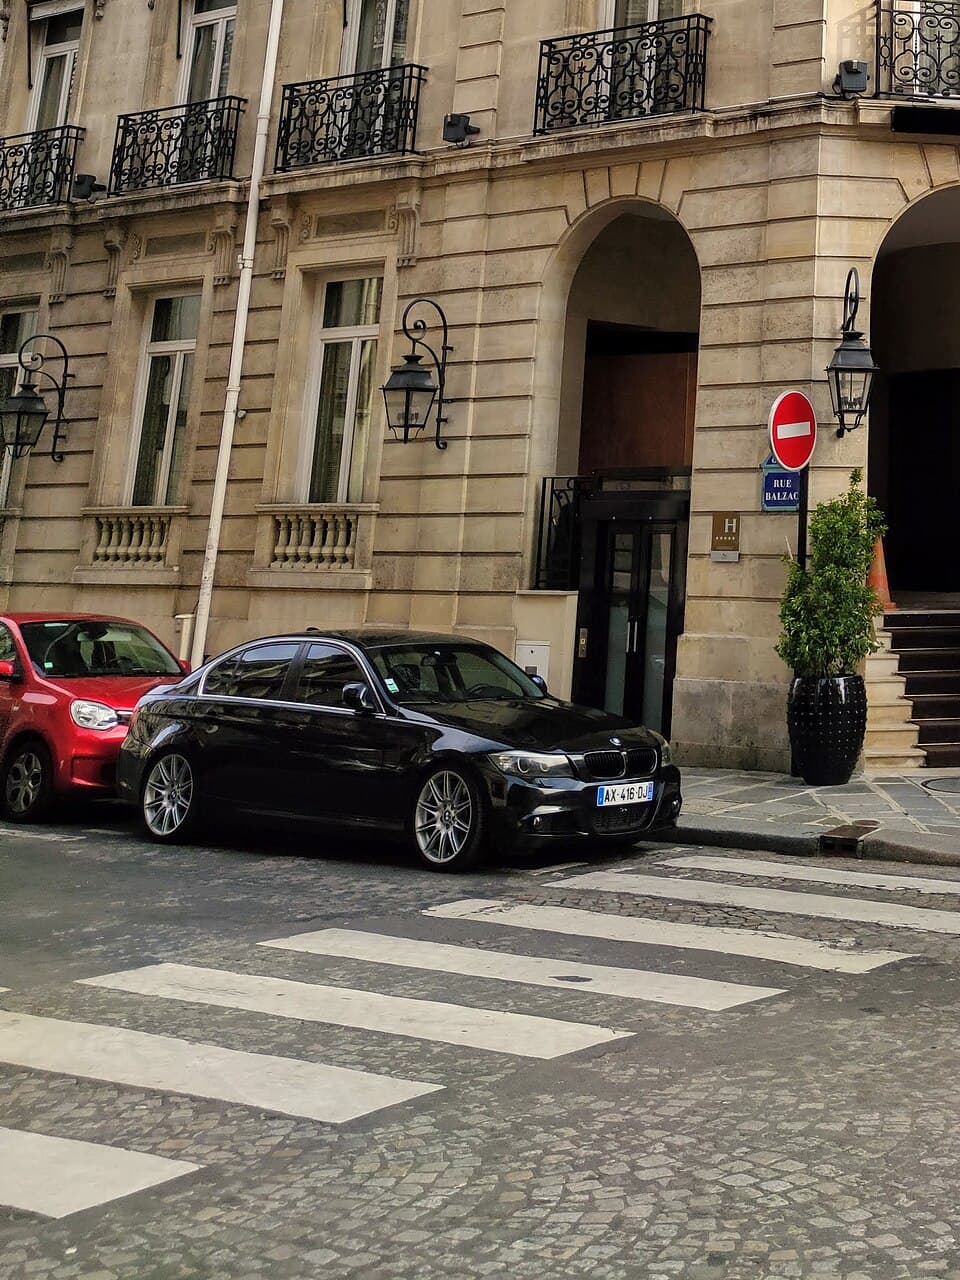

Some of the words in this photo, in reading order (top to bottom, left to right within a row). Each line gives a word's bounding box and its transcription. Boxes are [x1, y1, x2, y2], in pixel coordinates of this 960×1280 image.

[773, 479, 792, 488] RUE
[765, 491, 799, 501] BALZAC
[724, 518, 737, 533] H
[604, 785, 648, 803] AX-416-DJ
